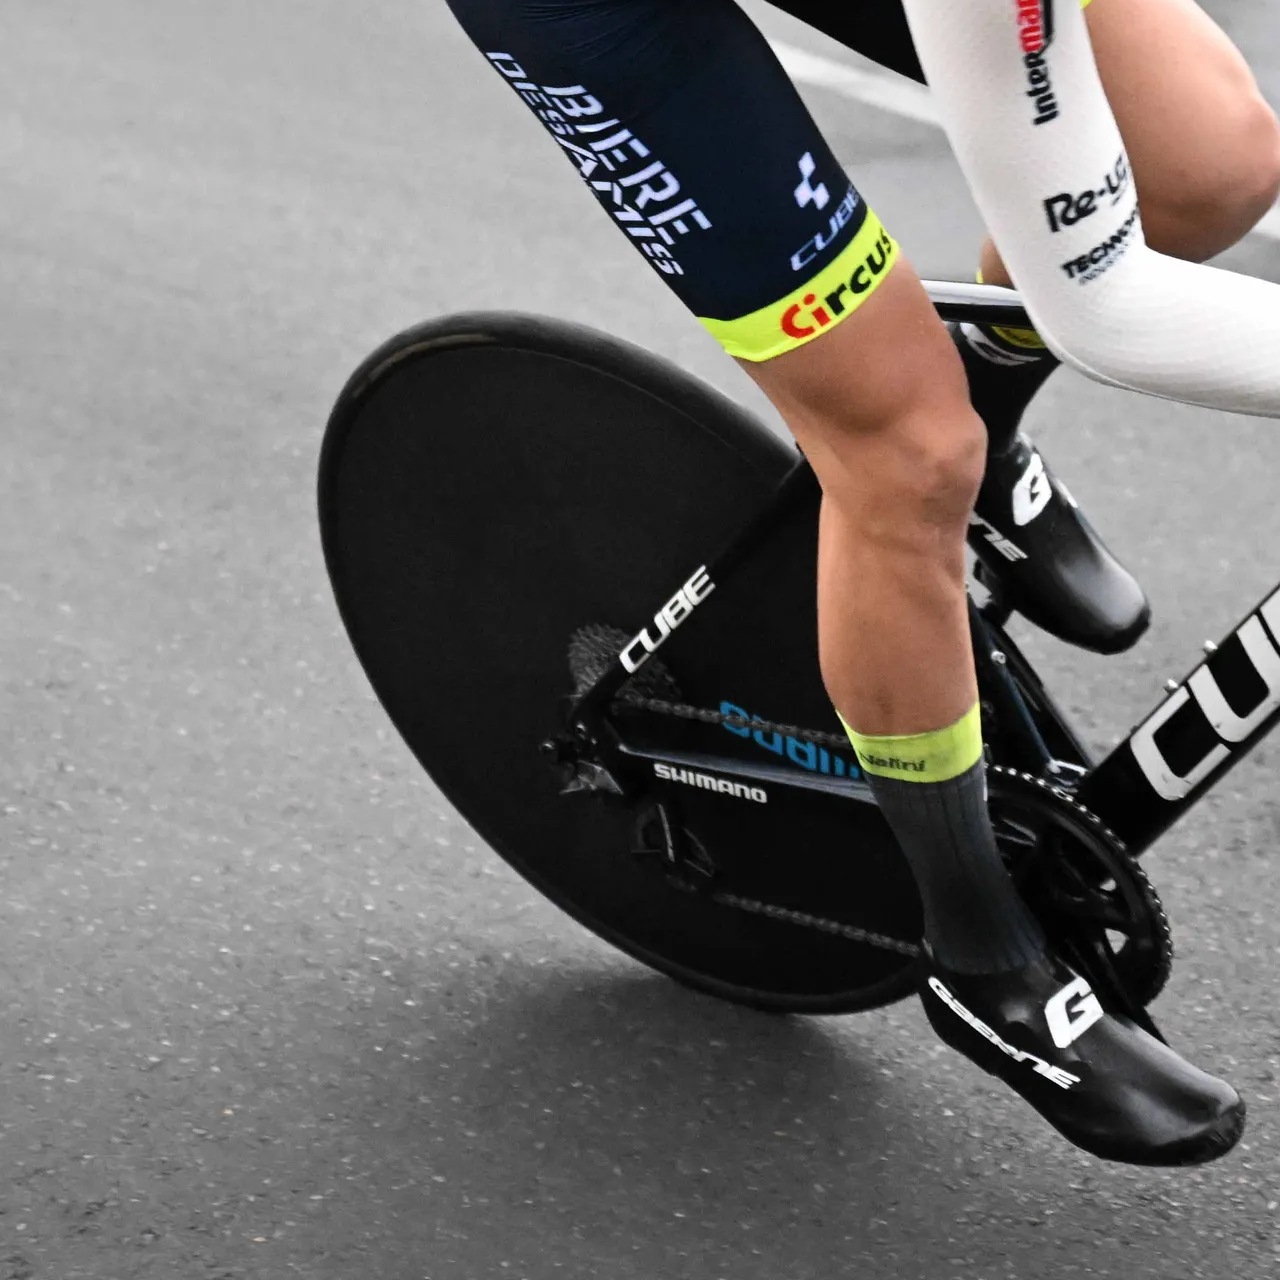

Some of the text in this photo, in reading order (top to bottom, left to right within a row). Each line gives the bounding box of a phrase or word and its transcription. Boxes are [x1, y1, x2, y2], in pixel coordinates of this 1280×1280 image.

[780, 228, 893, 339] Circus
[619, 565, 716, 674] CUBE
[653, 763, 767, 804] SHIMANO
[858, 751, 925, 773] Nalini
